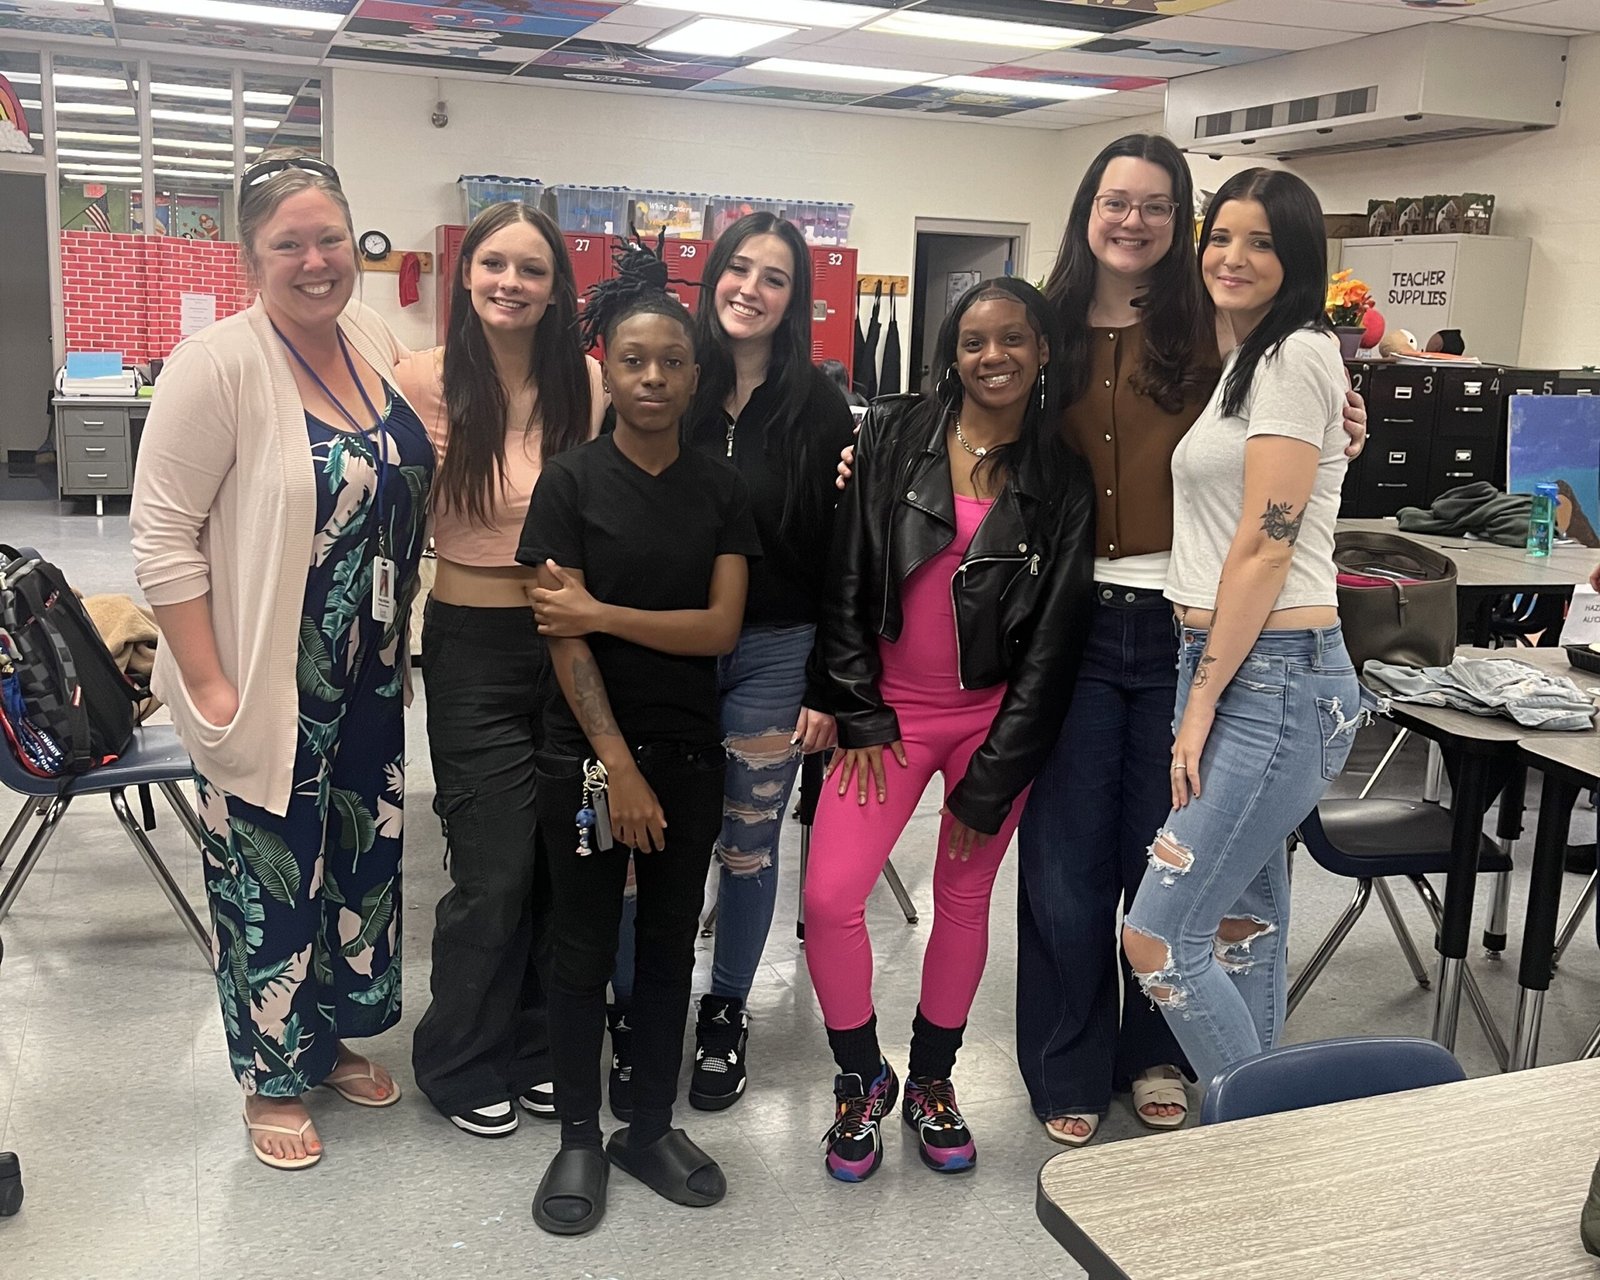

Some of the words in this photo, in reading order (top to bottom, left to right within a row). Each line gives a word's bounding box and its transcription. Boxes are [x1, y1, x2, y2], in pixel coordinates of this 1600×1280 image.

[649, 202, 667, 211] White
[669, 203, 693, 213] Borders
[575, 239, 590, 251] 27
[680, 245, 696, 258] 29
[828, 253, 843, 265] 32
[1392, 270, 1446, 287] TEACHER
[1388, 289, 1447, 306] SUPPLIES
[1353, 373, 1363, 391] 2
[1423, 376, 1433, 394] 3
[1489, 377, 1500, 395] 4
[1542, 381, 1554, 396] 5
